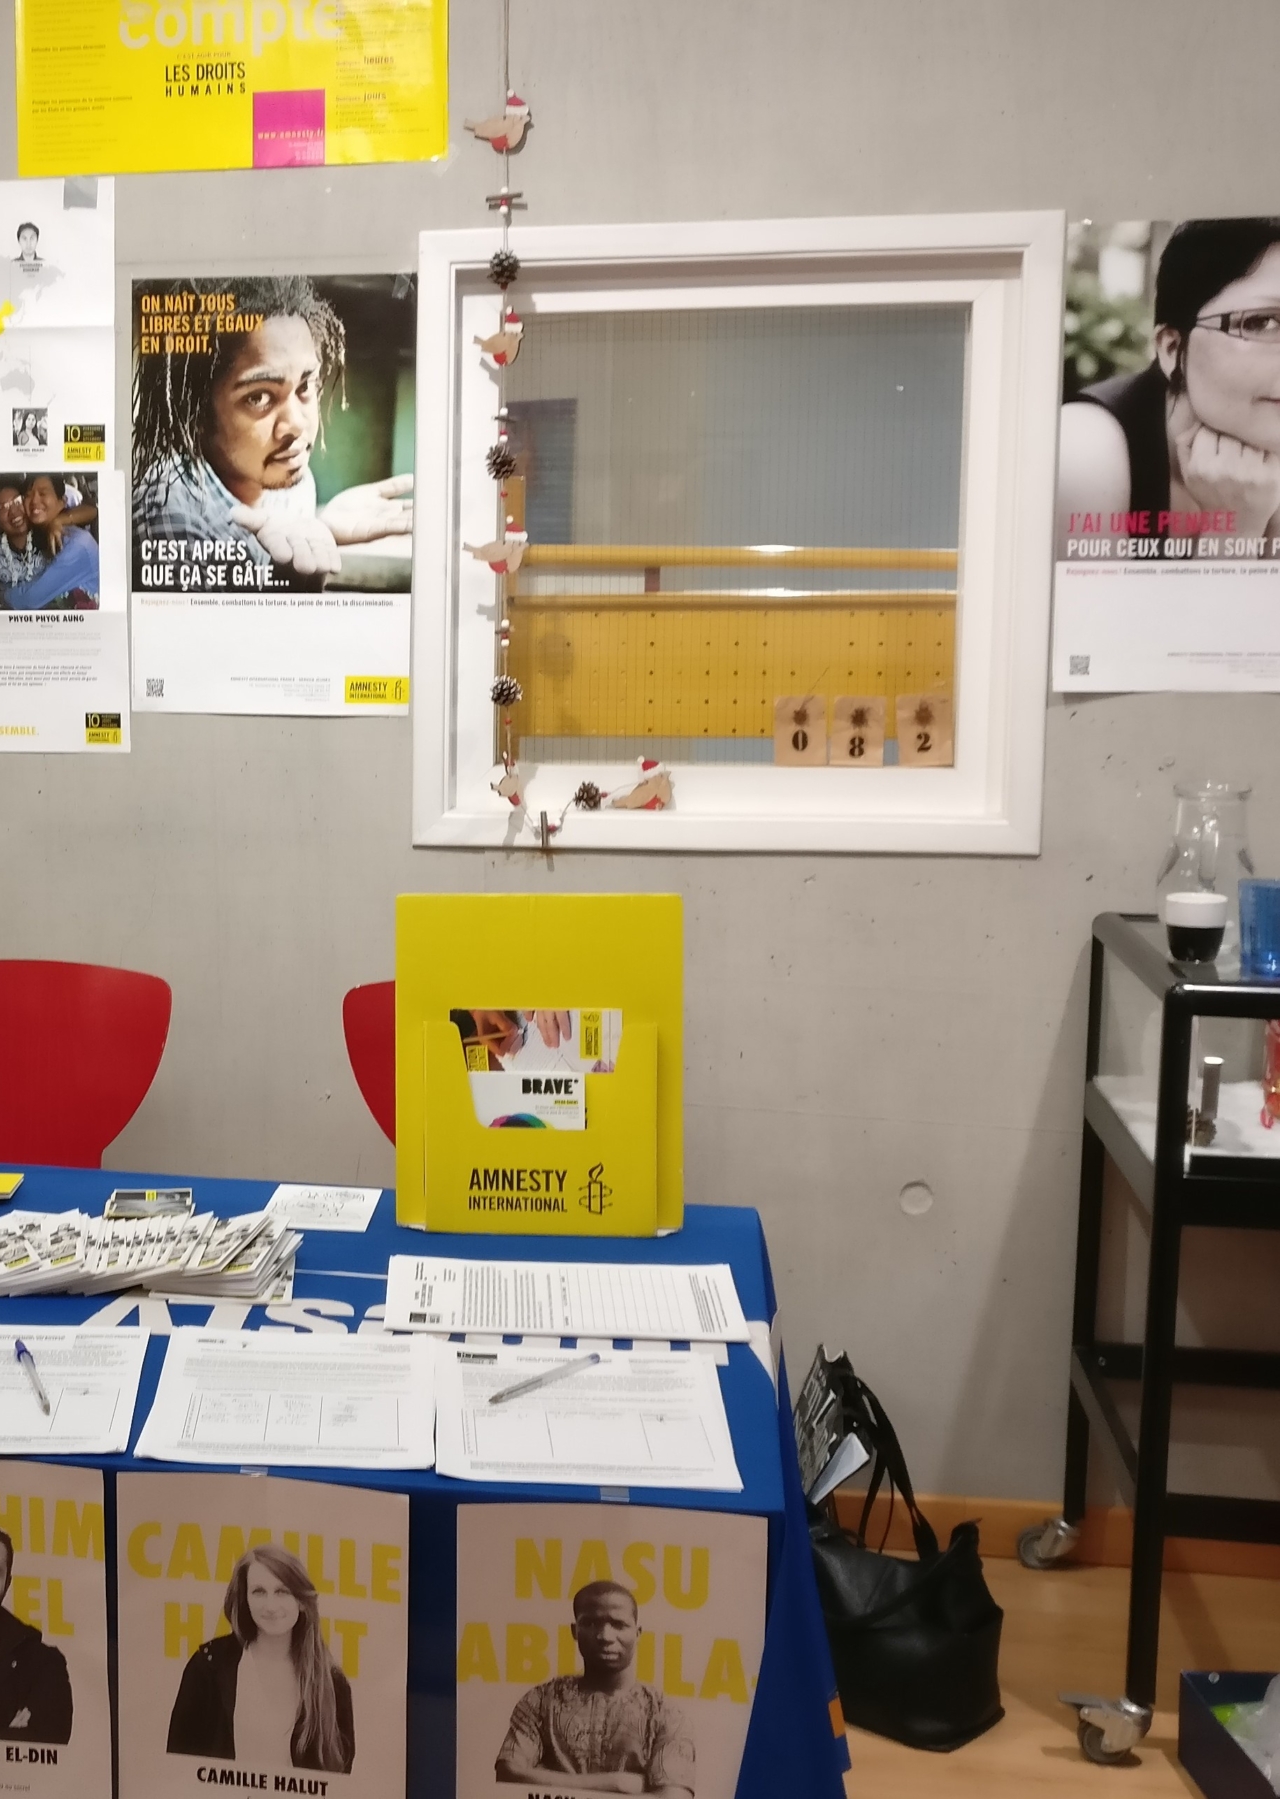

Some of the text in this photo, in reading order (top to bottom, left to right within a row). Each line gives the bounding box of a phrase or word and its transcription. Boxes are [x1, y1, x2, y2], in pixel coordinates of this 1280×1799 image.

[364, 54, 394, 65] heures
[165, 61, 246, 83] LES DROITS
[165, 82, 246, 97] HUMAINS
[363, 91, 387, 103] jours
[141, 291, 236, 313] ON NAÎT TOUS
[141, 309, 265, 335] LIBRES ET ÉGAUX
[141, 334, 213, 356] EN DROIT,
[66, 425, 81, 441] 10
[1067, 511, 1102, 534] J'AI
[1110, 510, 1151, 533] UNE
[141, 537, 247, 561] C'EST APRÈS
[1066, 537, 1112, 558] POUR
[1116, 537, 1161, 558] CEUX
[1163, 537, 1193, 558] QUI
[1197, 537, 1220, 557] EN
[1224, 536, 1268, 558] SONT
[141, 560, 290, 592] QUE ÇA SE GÂTE...
[8, 614, 85, 623] PHYOE PHYOE AUNG
[349, 681, 388, 692] AMNESTY
[349, 692, 388, 700] INTERNATIONAL
[87, 713, 100, 728] 10
[792, 729, 932, 758] 0 8 2
[522, 1078, 573, 1094] BRAVE
[469, 1168, 568, 1193] AMNESTY
[468, 1195, 568, 1214] INTERNATIONAL
[514, 1537, 710, 1611] NASU
[5, 1746, 58, 1765] EL-DIN
[196, 1766, 328, 1797] CAMILLE HALUT
